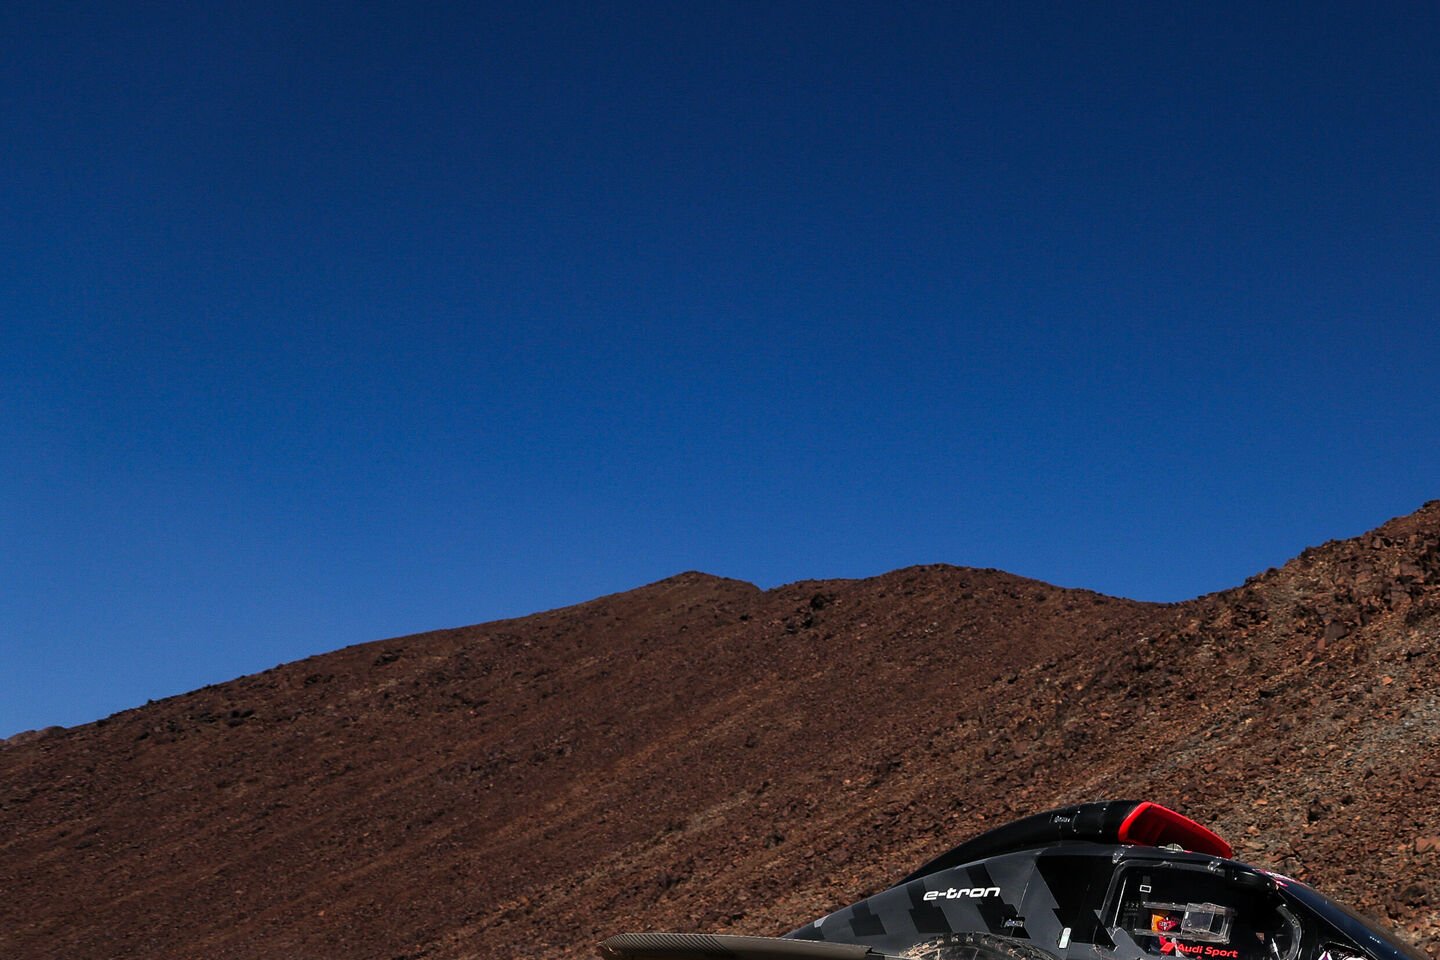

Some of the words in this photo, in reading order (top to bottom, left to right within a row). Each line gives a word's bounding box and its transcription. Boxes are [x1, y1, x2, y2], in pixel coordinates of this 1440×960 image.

[923, 887, 1001, 901] e-tron
[1177, 943, 1204, 954] Audi
[1204, 946, 1239, 958] Sport
